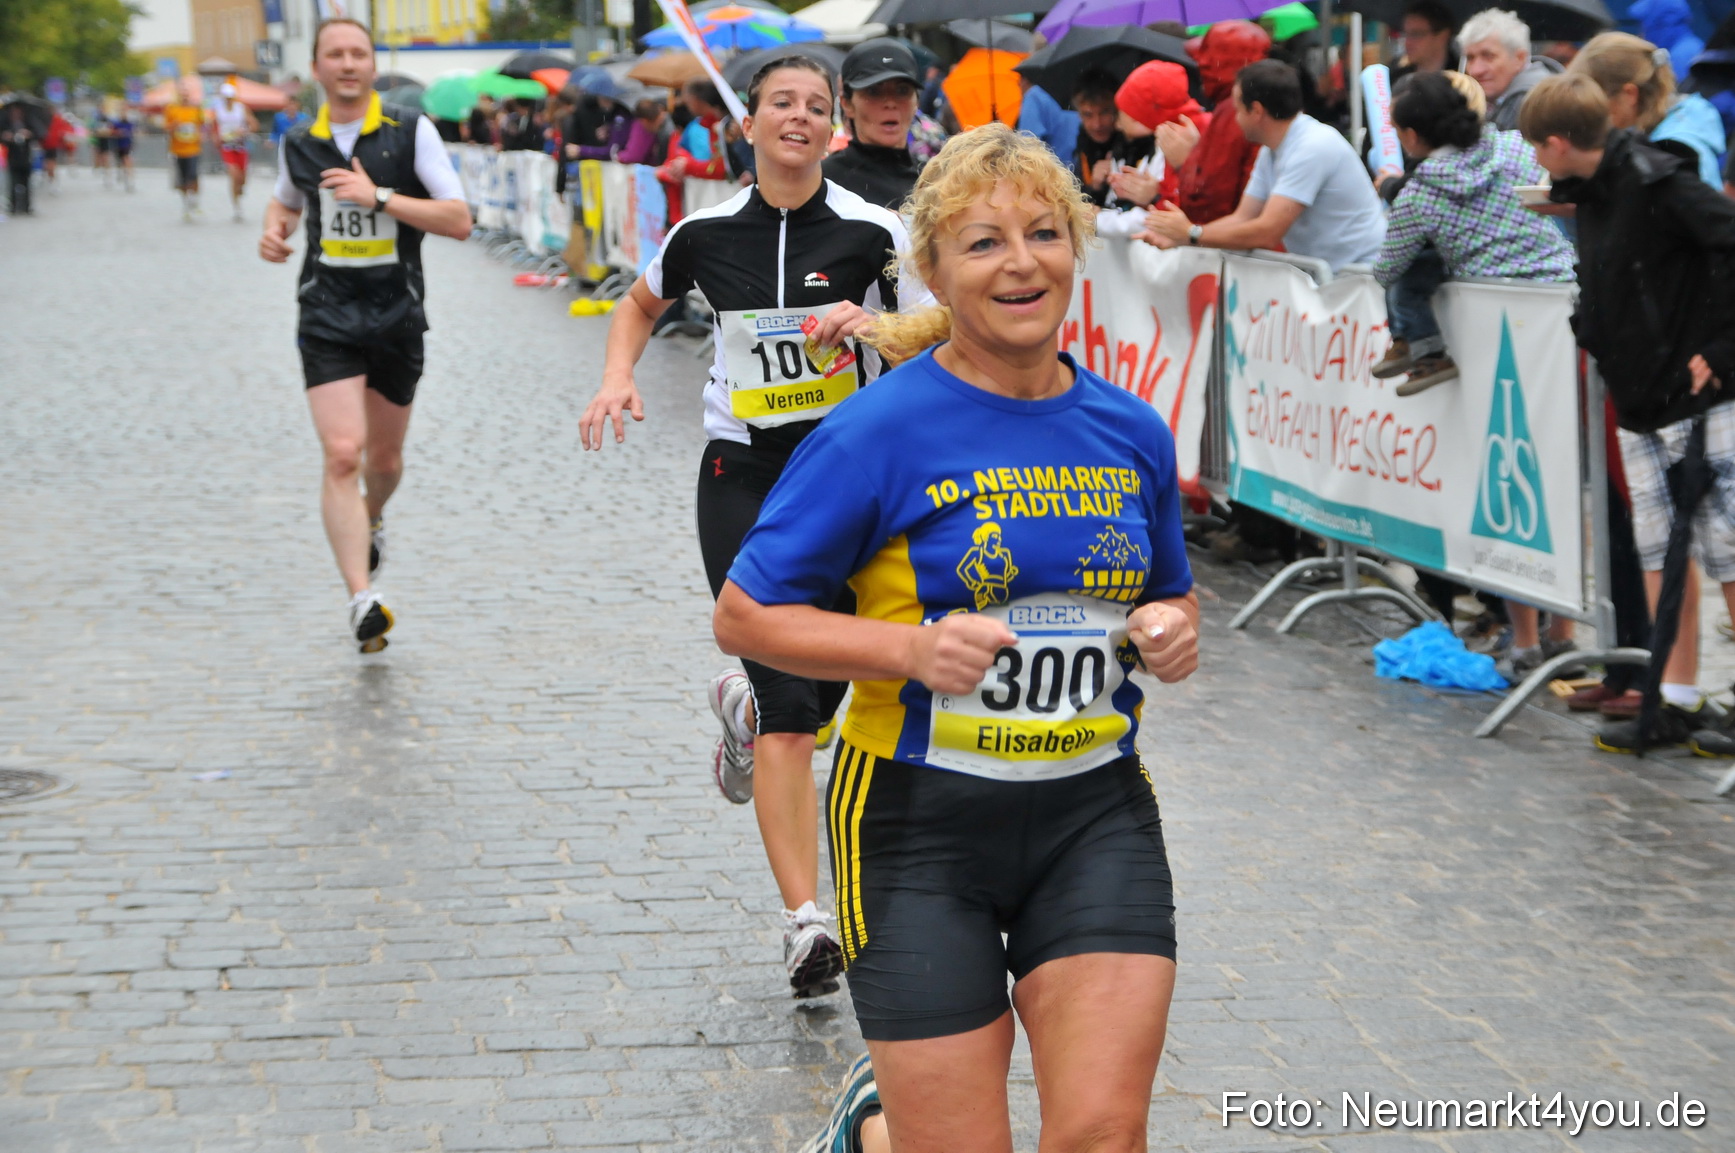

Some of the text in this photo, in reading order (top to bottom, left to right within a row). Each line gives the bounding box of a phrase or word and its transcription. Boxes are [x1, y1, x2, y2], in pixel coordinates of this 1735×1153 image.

[331, 211, 377, 237] 481
[804, 279, 830, 287] skinfit
[765, 389, 825, 410] Verena
[925, 466, 1141, 509] 10. NEUMARKTER
[973, 491, 1123, 520] STADTLAUF
[1009, 606, 1087, 625] BOCK
[981, 646, 1106, 713] 300
